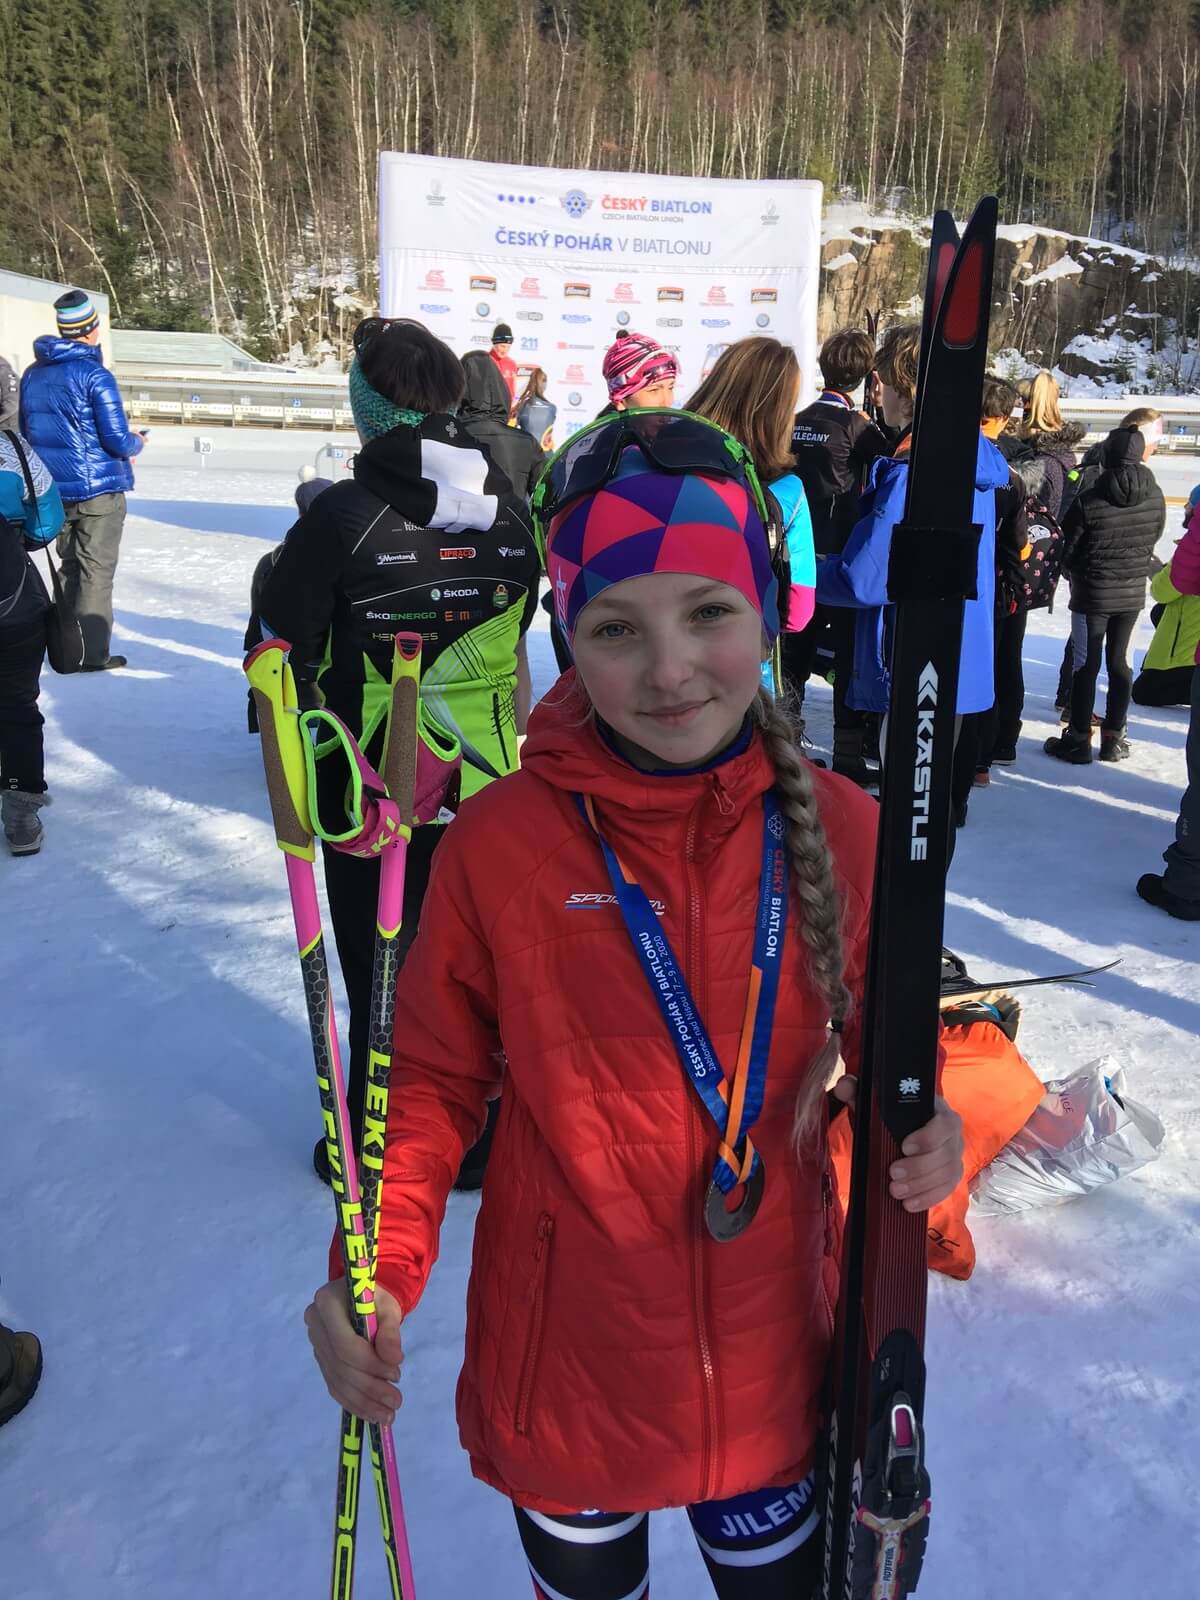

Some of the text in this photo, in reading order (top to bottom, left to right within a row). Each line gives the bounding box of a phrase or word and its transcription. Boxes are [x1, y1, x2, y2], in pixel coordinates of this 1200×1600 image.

[601, 194, 712, 214] ČESKÝ BIATLON
[495, 226, 711, 255] ČESKÝ POHÁR V BIATLONU
[443, 588, 480, 598] ŠKODA
[366, 611, 437, 621] ŠKOENERGO
[766, 897, 782, 957] BIATLON
[653, 935, 669, 958] 2020
[639, 931, 707, 1078] ČESKÝ POHÁR V BIATLONU
[680, 995, 695, 1020] Nisou
[361, 1048, 391, 1170] LEKI
[341, 1202, 375, 1315] LEKI
[721, 1477, 815, 1537] JILEM
